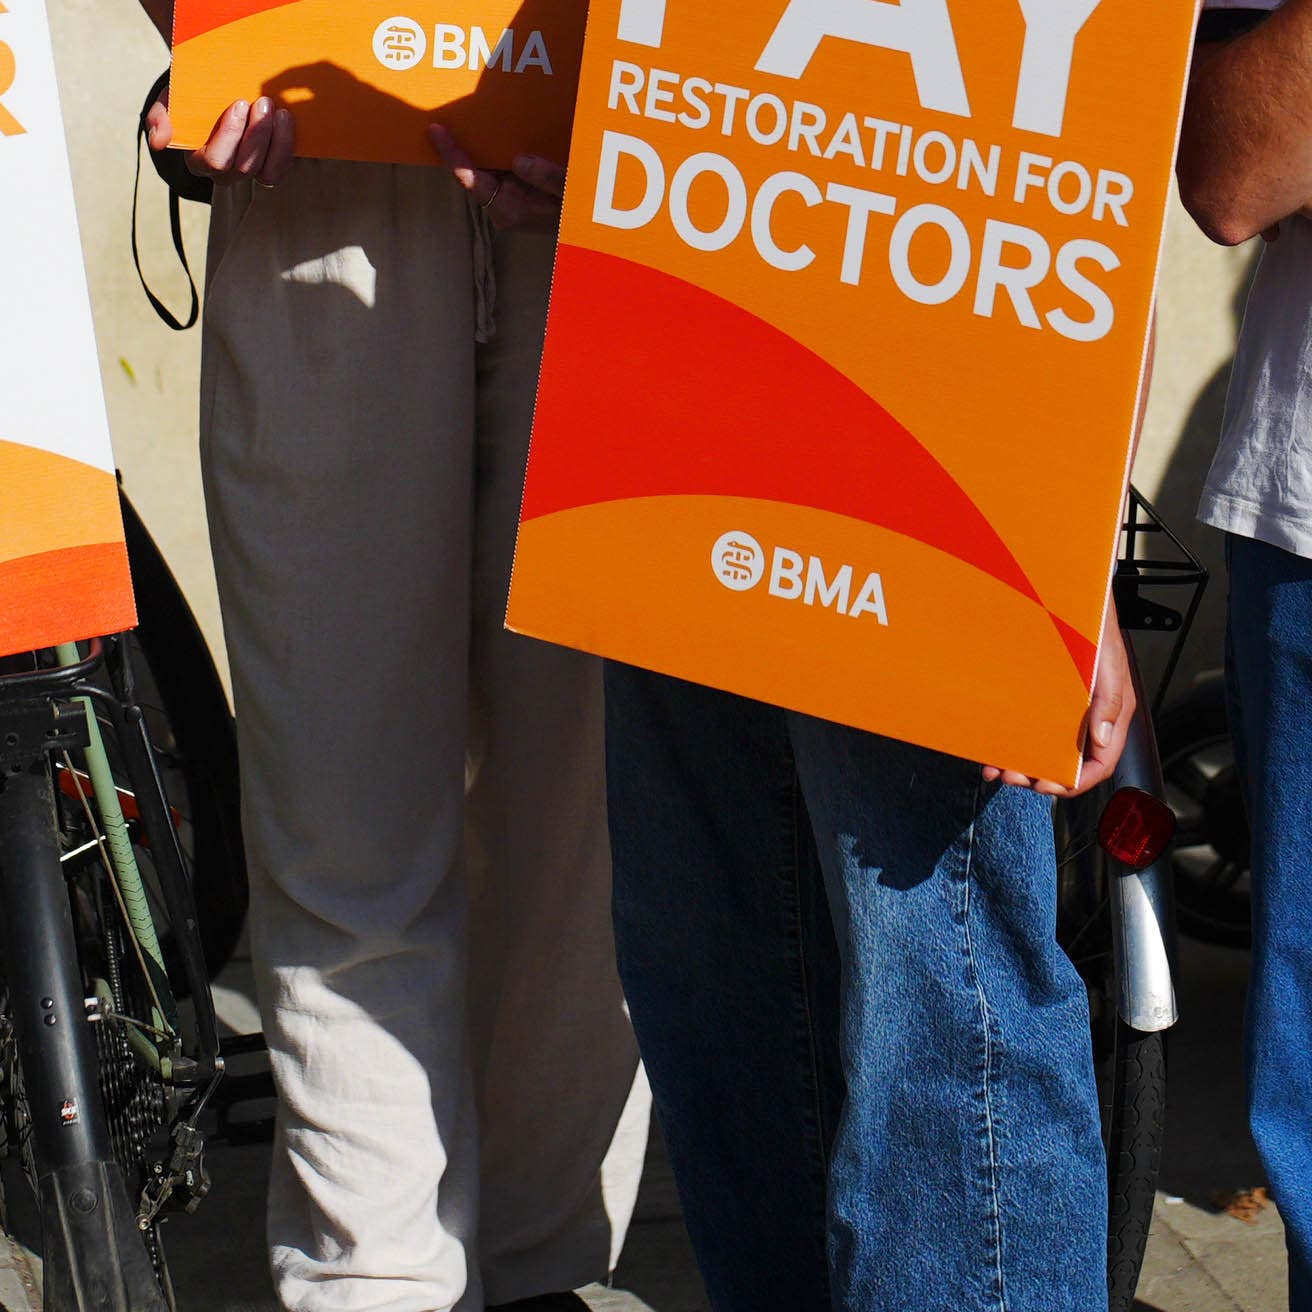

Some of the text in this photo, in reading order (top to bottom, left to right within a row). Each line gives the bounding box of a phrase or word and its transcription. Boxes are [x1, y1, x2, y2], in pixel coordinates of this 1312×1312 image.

[433, 24, 552, 75] BMA
[607, 59, 1134, 226] RESTORATION FOR
[592, 130, 1121, 342] DOCTORS
[768, 546, 888, 626] BMA
